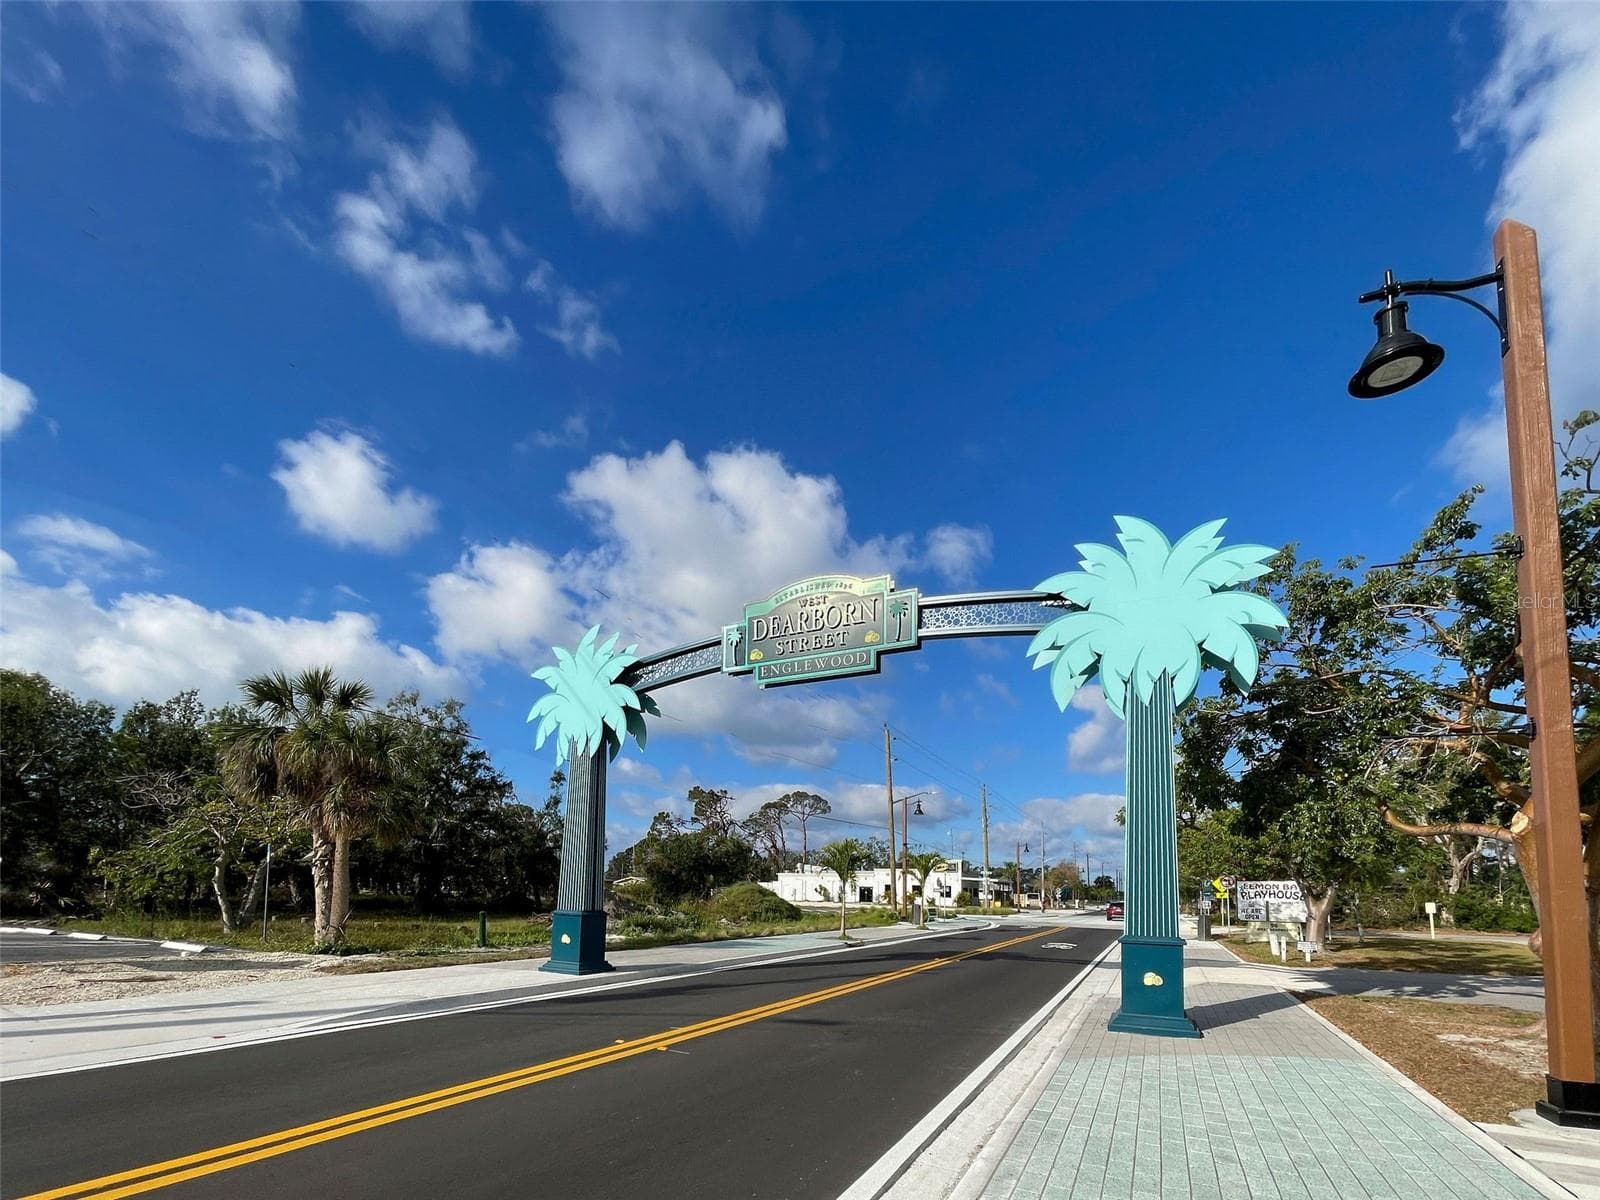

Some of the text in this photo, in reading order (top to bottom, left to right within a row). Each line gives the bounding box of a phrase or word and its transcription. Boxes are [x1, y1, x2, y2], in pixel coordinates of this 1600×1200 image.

[799, 594, 828, 608] WEST
[752, 599, 878, 641] DEARBORN
[776, 631, 849, 656] STREET
[760, 652, 867, 677] ENGLEWOOD
